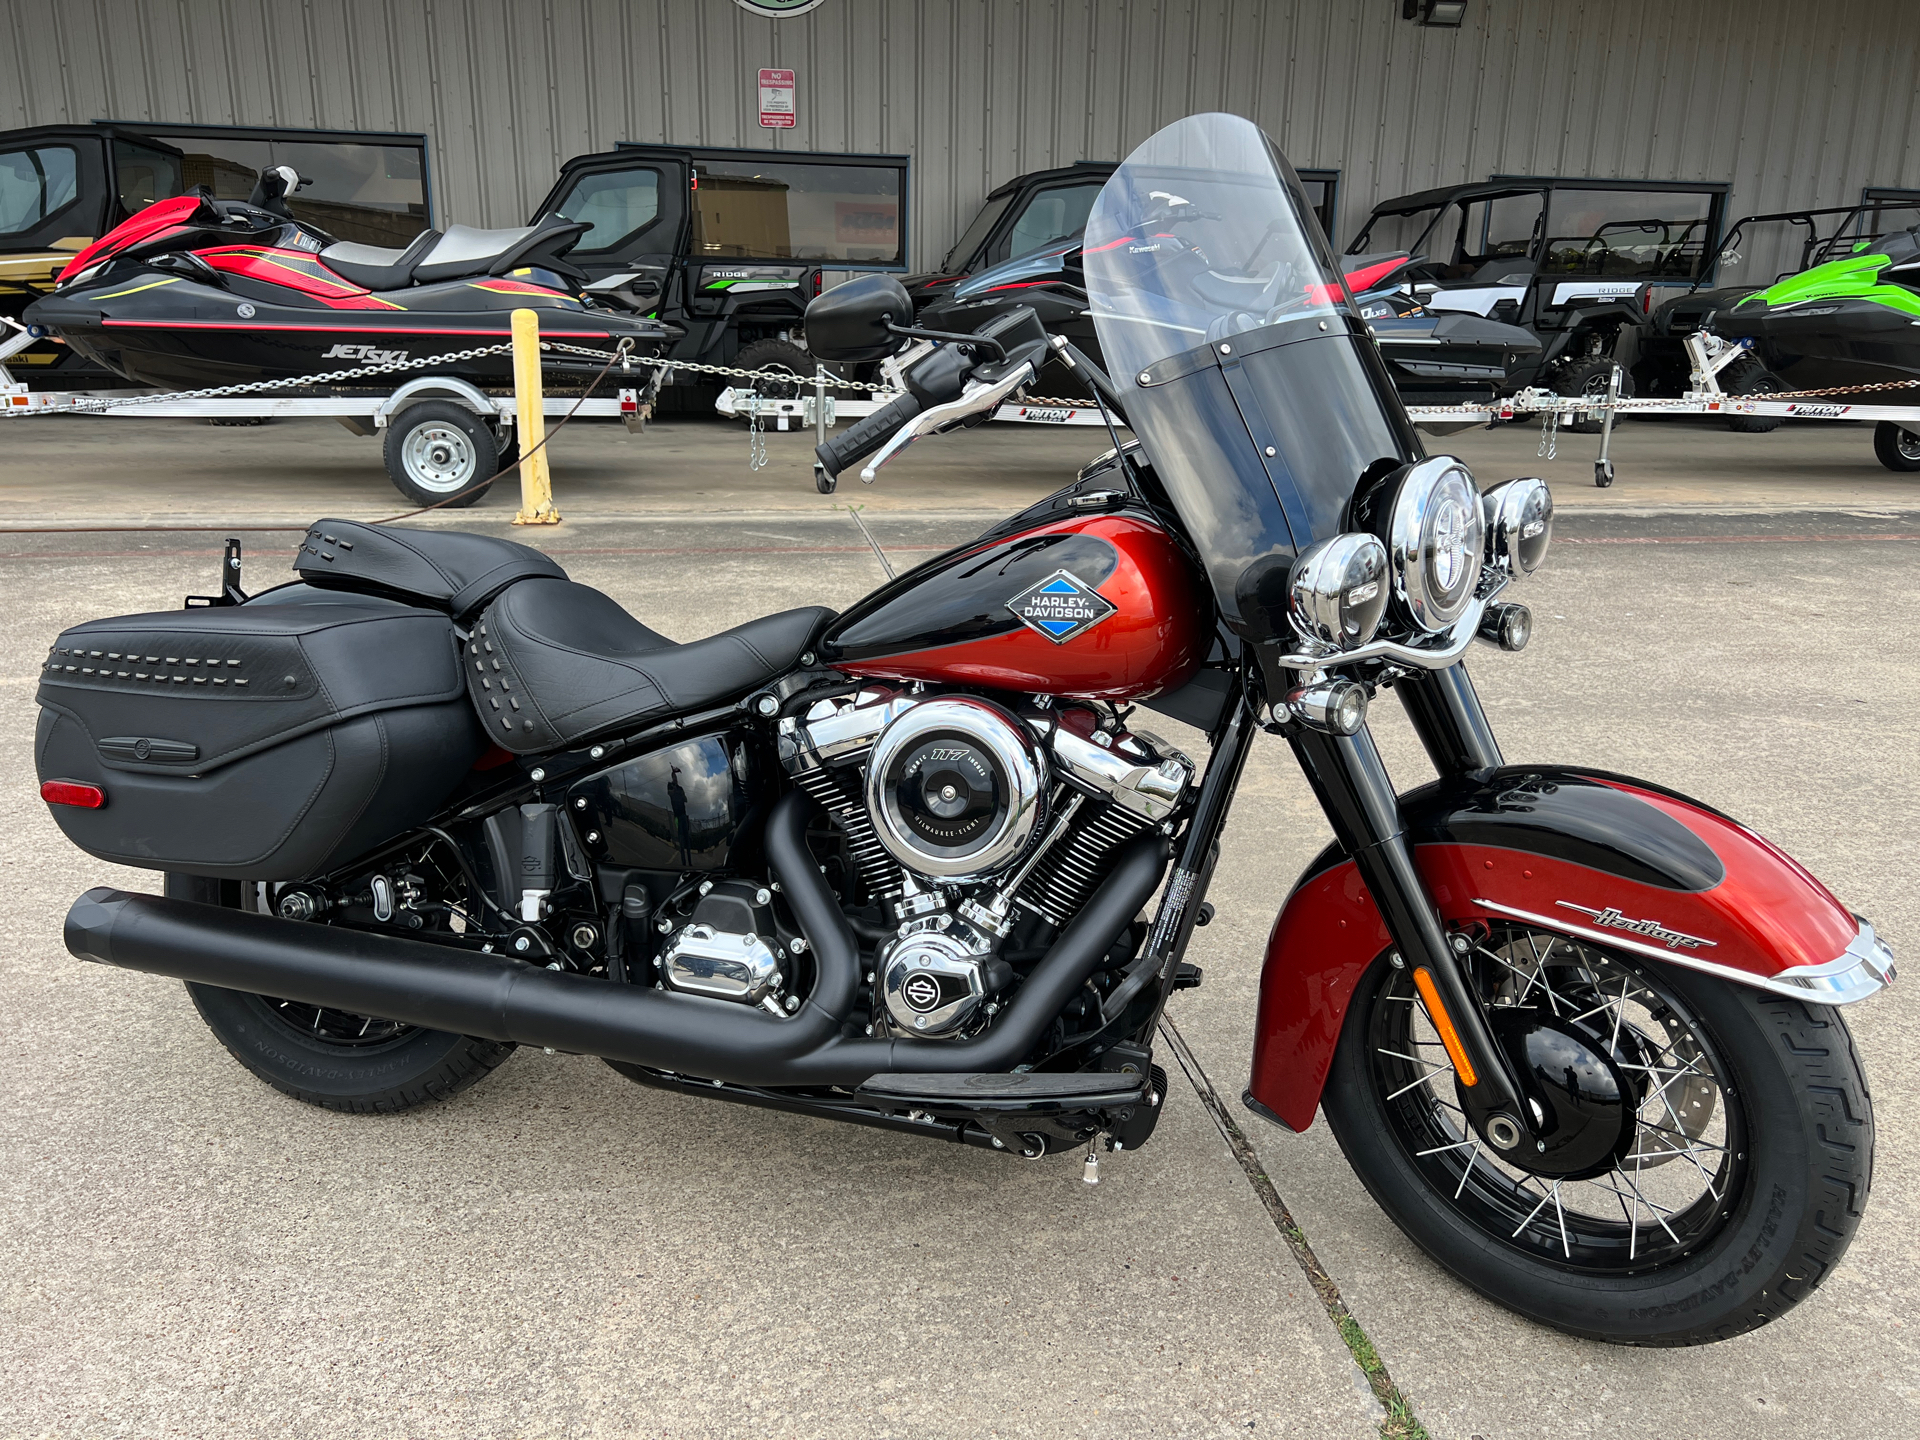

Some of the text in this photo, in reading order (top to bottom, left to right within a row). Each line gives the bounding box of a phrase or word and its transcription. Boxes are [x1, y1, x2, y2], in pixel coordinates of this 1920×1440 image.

[1025, 408, 1071, 419] TRITON
[1794, 405, 1847, 414] TRITON
[1024, 607, 1094, 619] DAVIDSON
[1031, 596, 1090, 608] HARLEY-
[909, 748, 986, 777] CUBIC 117 INCHES
[914, 815, 980, 837] MILWAUKEE-EIGHT
[1593, 906, 1701, 948] Heritage
[254, 1040, 412, 1081] HARLEY-DAVIDSON
[1628, 1182, 1788, 1321] HARLEY-DAVIDSON
